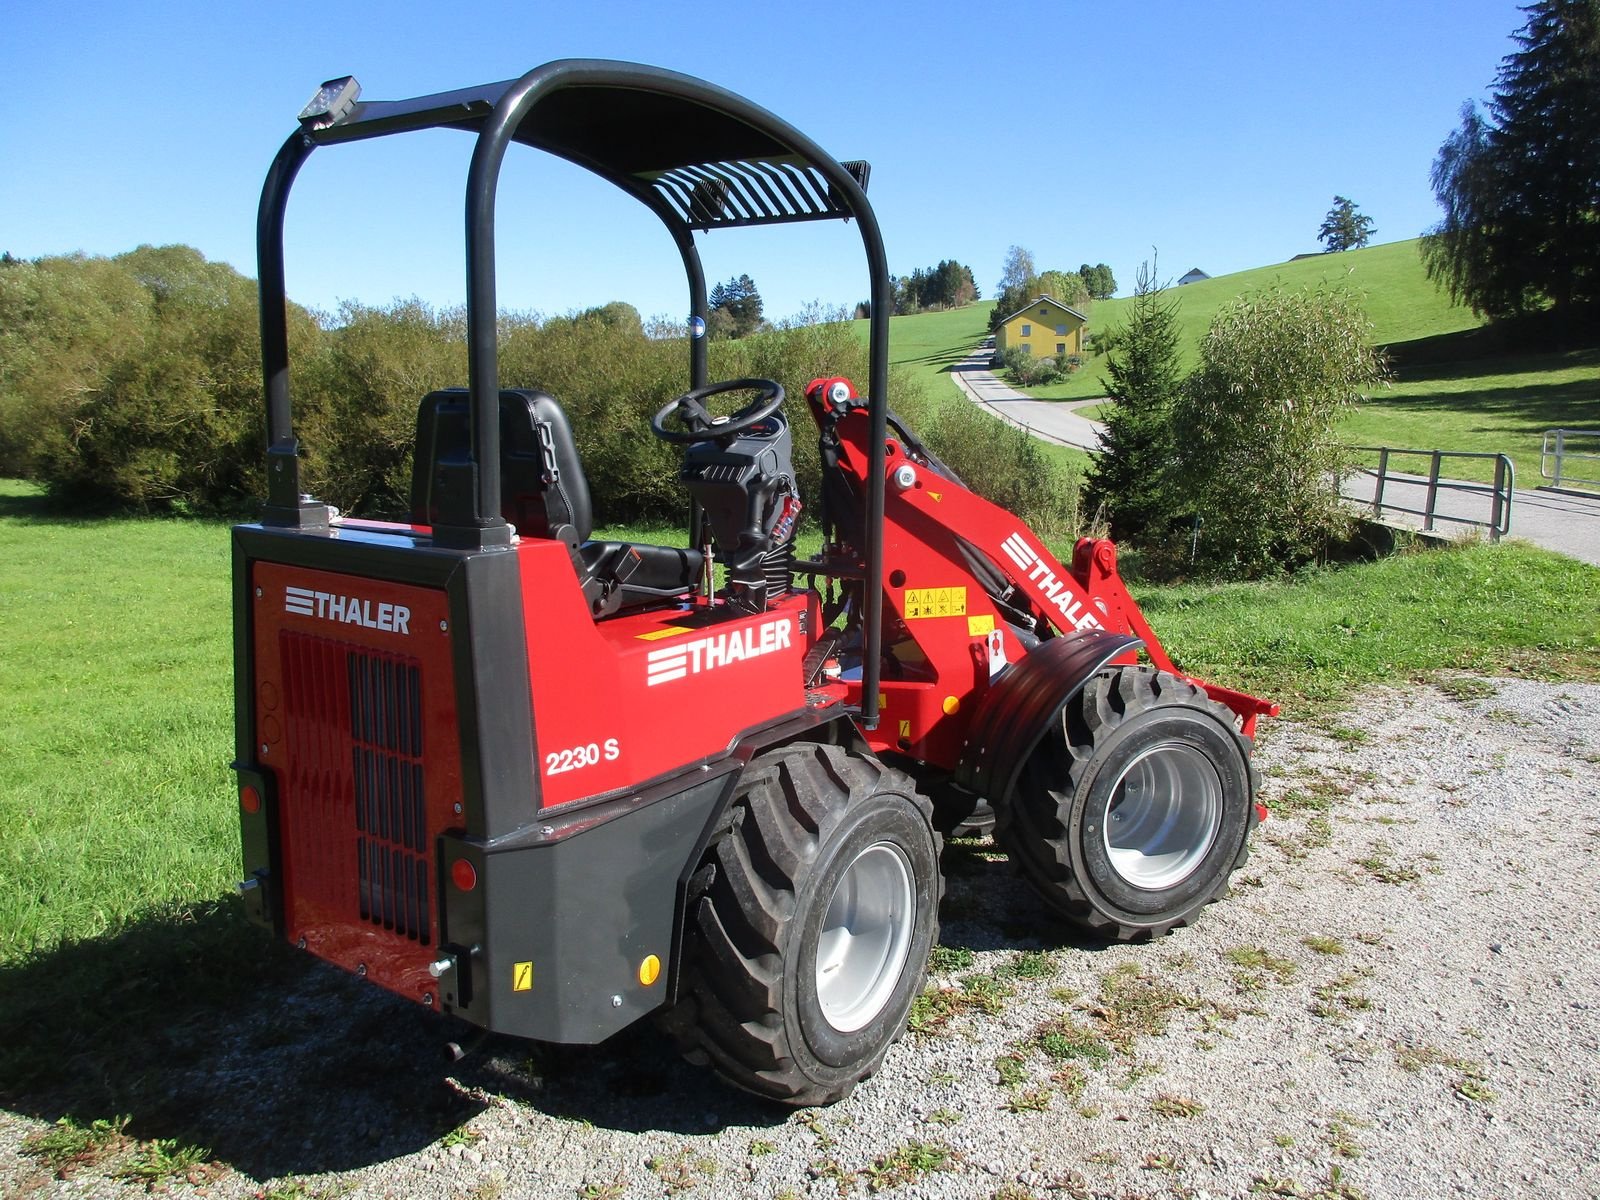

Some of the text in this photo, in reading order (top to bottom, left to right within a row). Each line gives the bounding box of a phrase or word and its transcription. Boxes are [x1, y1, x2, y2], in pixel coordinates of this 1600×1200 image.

[314, 591, 411, 635] THALER
[1028, 558, 1105, 632] THALE
[687, 618, 792, 673] THALER
[546, 738, 620, 776] 2230 S
